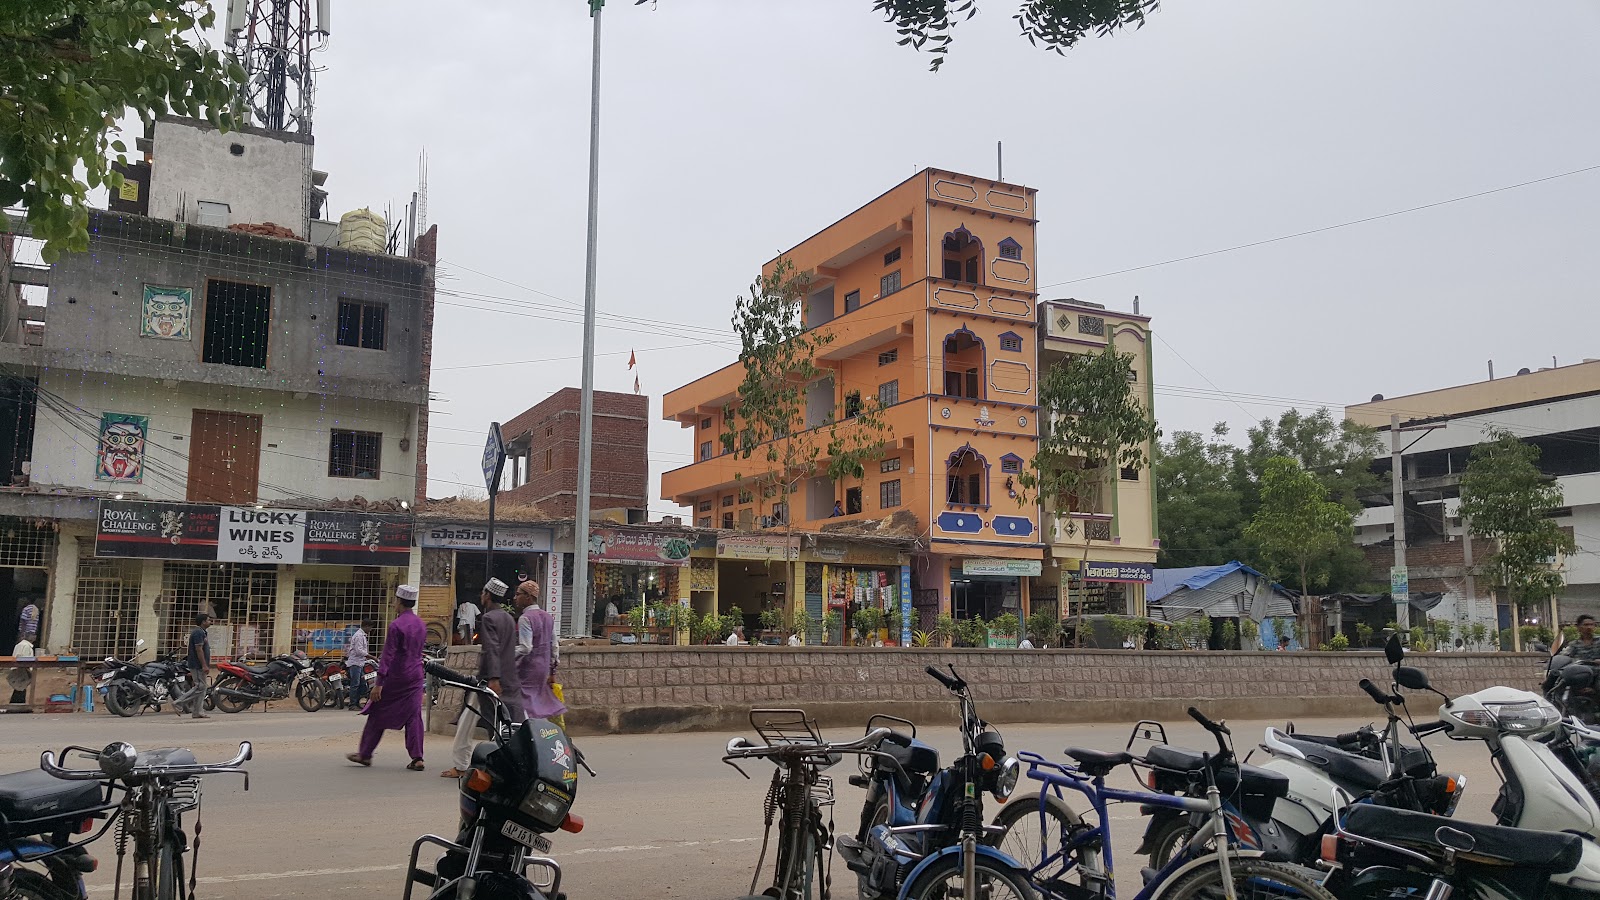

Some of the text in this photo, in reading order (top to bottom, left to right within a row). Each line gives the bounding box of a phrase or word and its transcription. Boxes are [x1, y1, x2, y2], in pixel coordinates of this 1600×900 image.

[103, 508, 139, 521] ROYAL
[229, 511, 298, 525] LUCKY
[102, 520, 157, 531] CHALLENGE
[309, 519, 341, 531] ROYAL
[229, 528, 295, 543] WINES
[308, 529, 357, 540] CHALLENGE
[431, 528, 487, 540] పావని
[617, 532, 636, 545] సాయి
[238, 545, 258, 559] లక్కీ
[504, 824, 518, 836] AP
[517, 829, 528, 841] 15
[526, 833, 535, 844] N
